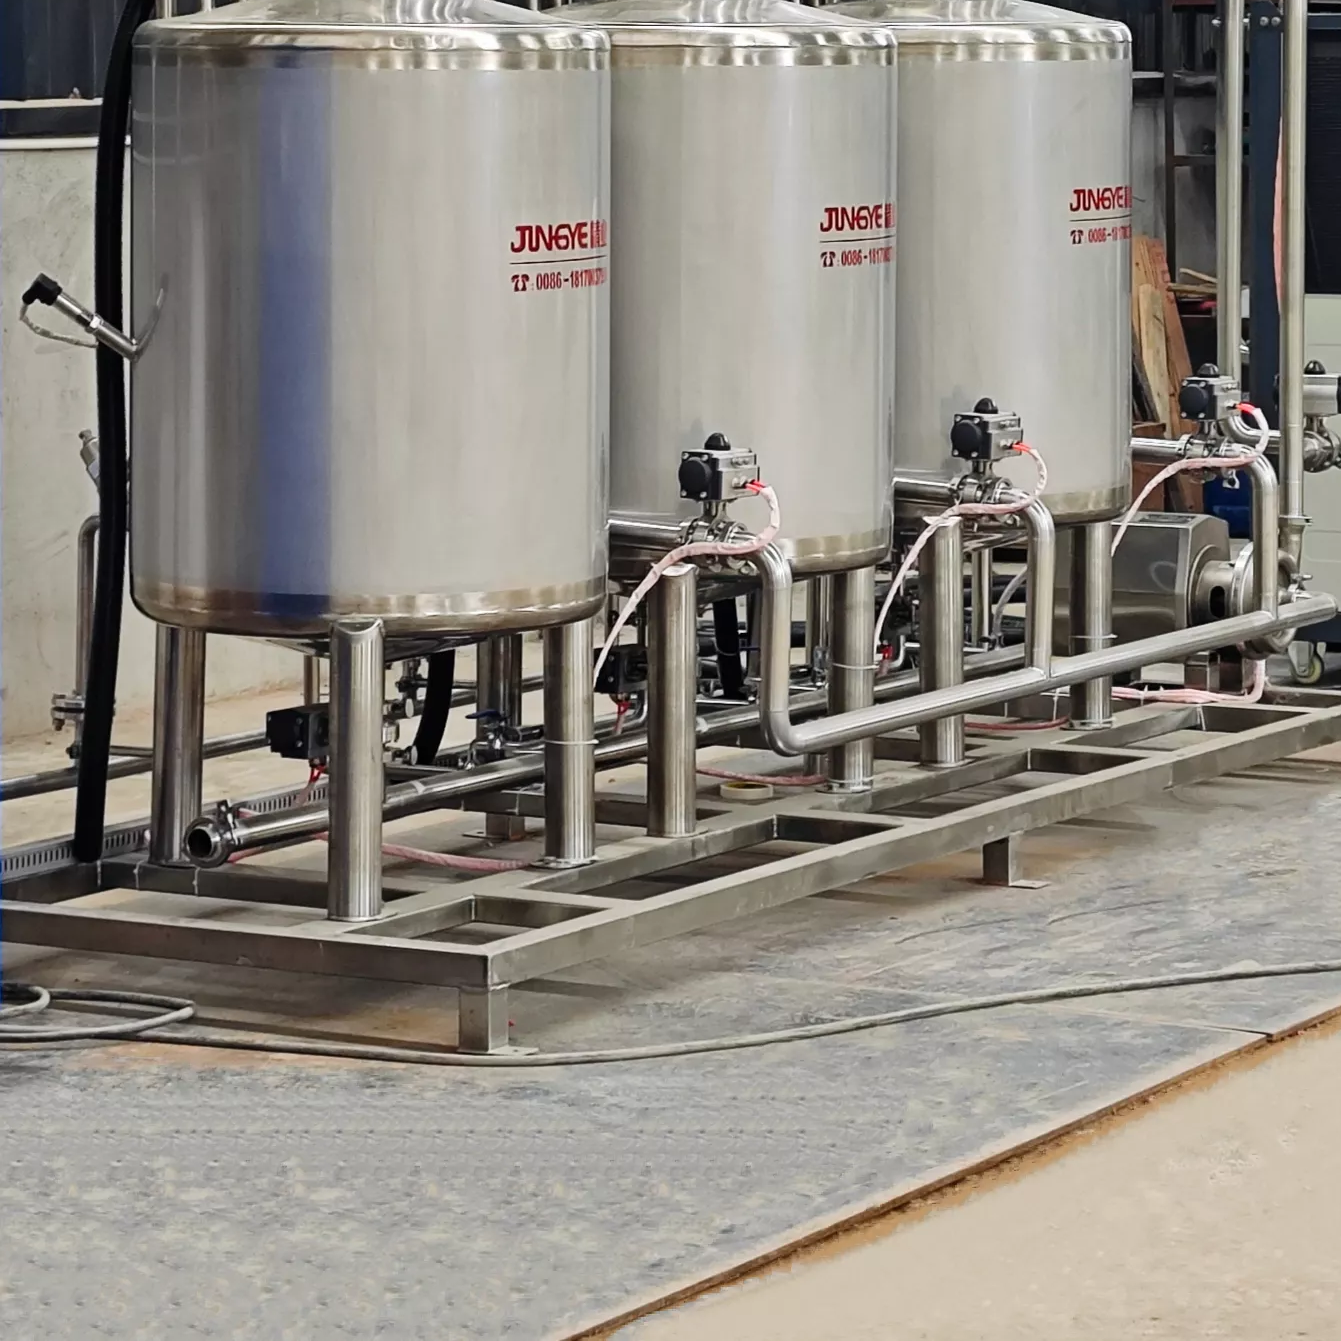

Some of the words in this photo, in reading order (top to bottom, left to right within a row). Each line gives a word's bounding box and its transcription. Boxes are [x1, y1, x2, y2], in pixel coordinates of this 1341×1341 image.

[1070, 186, 1123, 212] JINGYE
[820, 204, 883, 232] JINGYE
[511, 221, 588, 253] JINGYE
